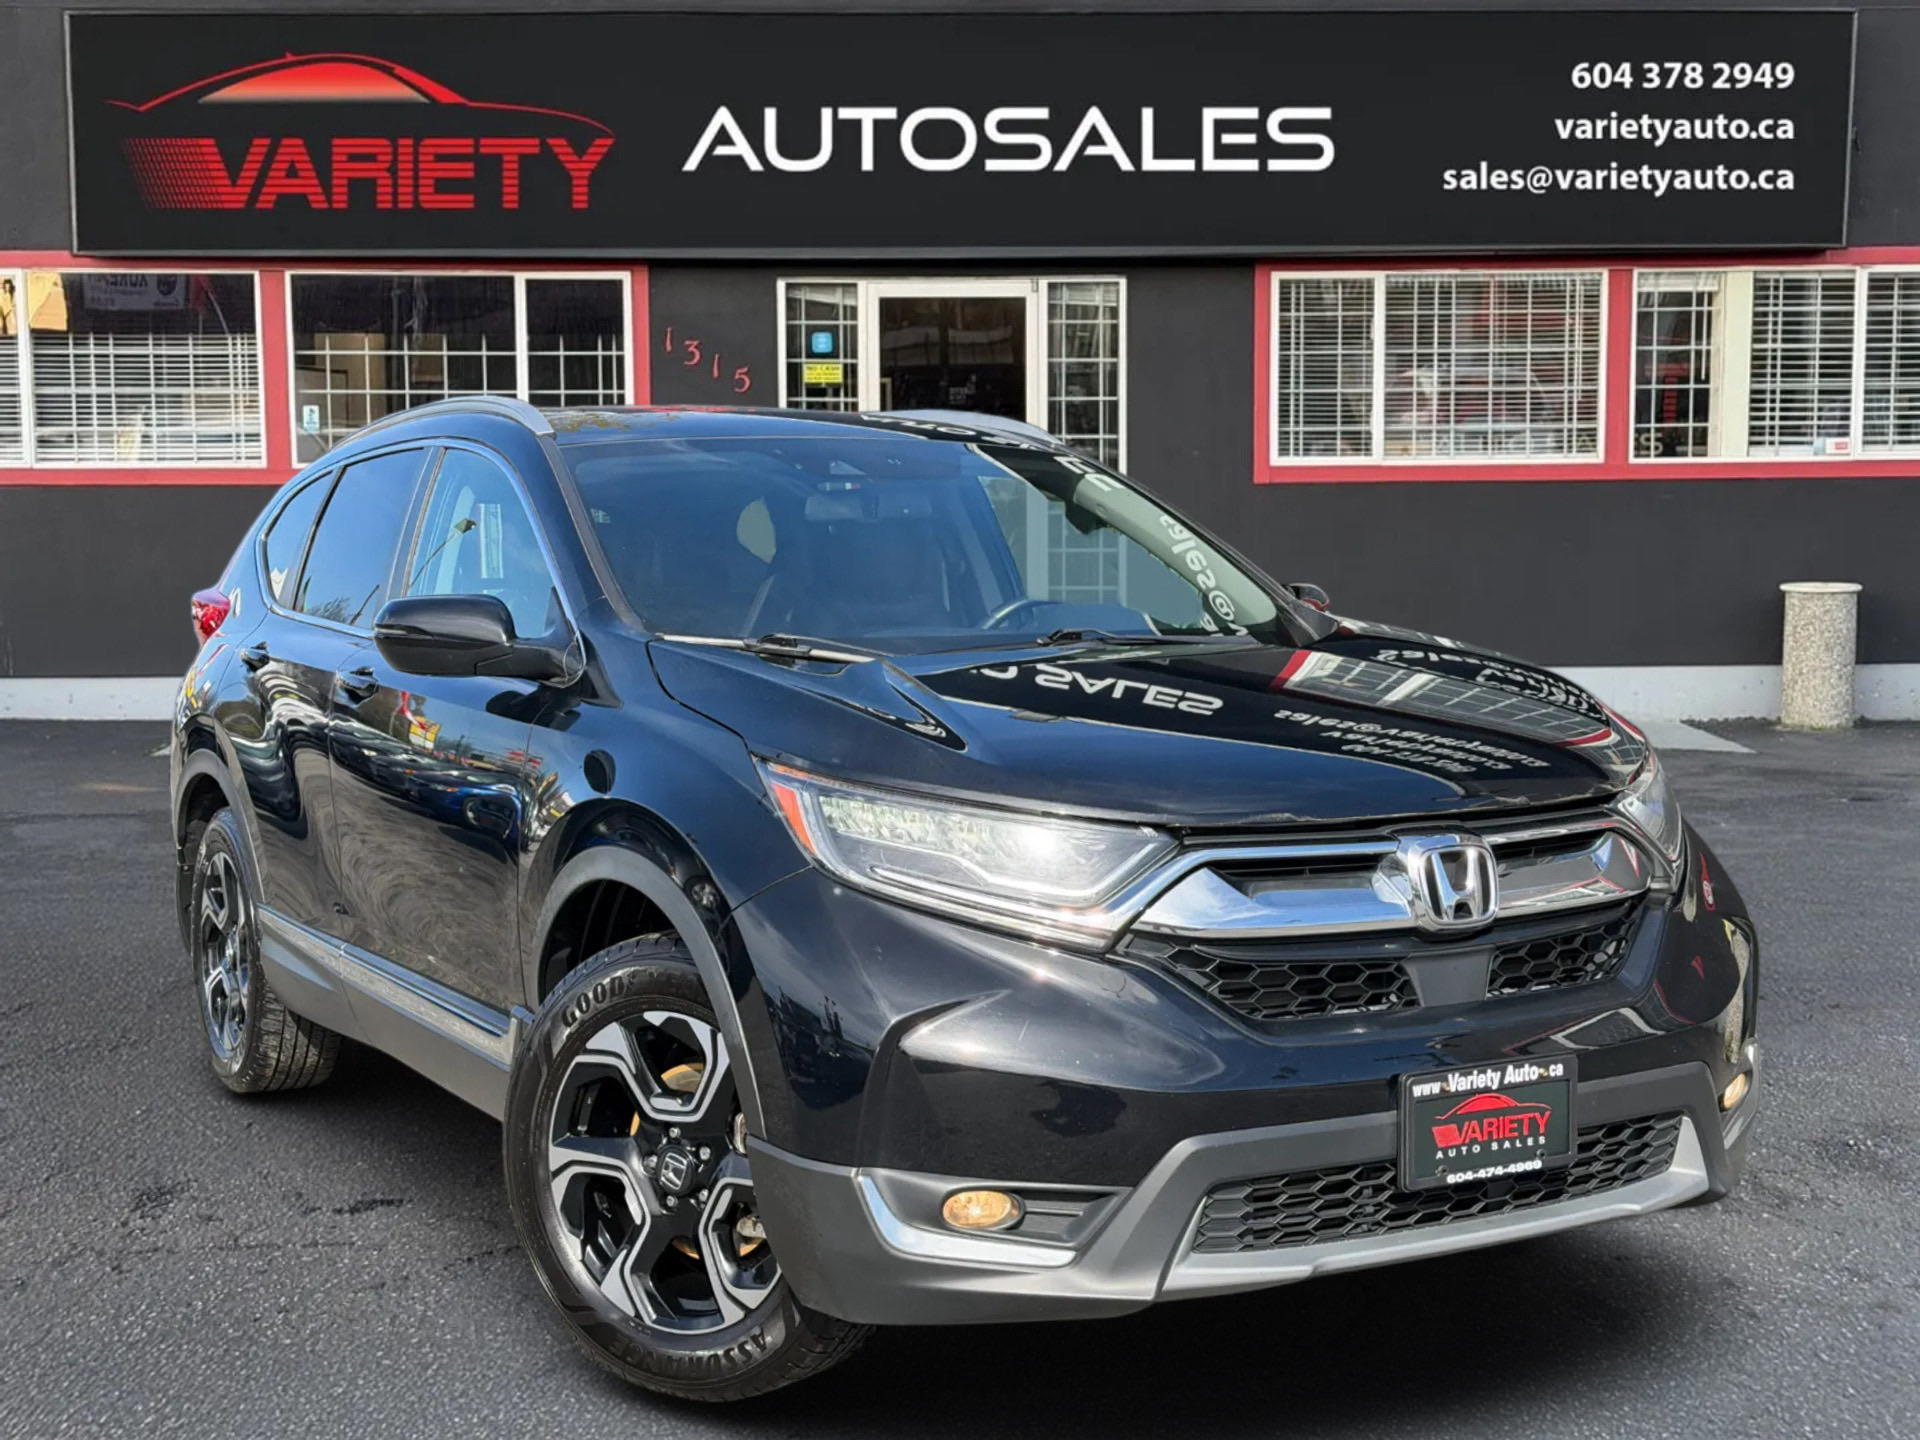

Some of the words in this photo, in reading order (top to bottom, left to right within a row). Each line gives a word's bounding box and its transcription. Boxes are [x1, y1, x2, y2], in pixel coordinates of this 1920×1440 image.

[1572, 61, 1634, 89] 604
[1642, 61, 1704, 89] 378
[1711, 61, 1795, 89] 2949
[681, 105, 1335, 173] AUTOSALES
[1554, 111, 1795, 148] varietyauto.ca
[126, 136, 615, 211] VARIETY
[1443, 160, 1795, 198] sales@varietyauto.ca
[666, 326, 751, 393] 1315
[1431, 1110, 1552, 1149] VARIETY
[1435, 1144, 1481, 1160] AUTO
[1491, 1135, 1546, 1151] SALES
